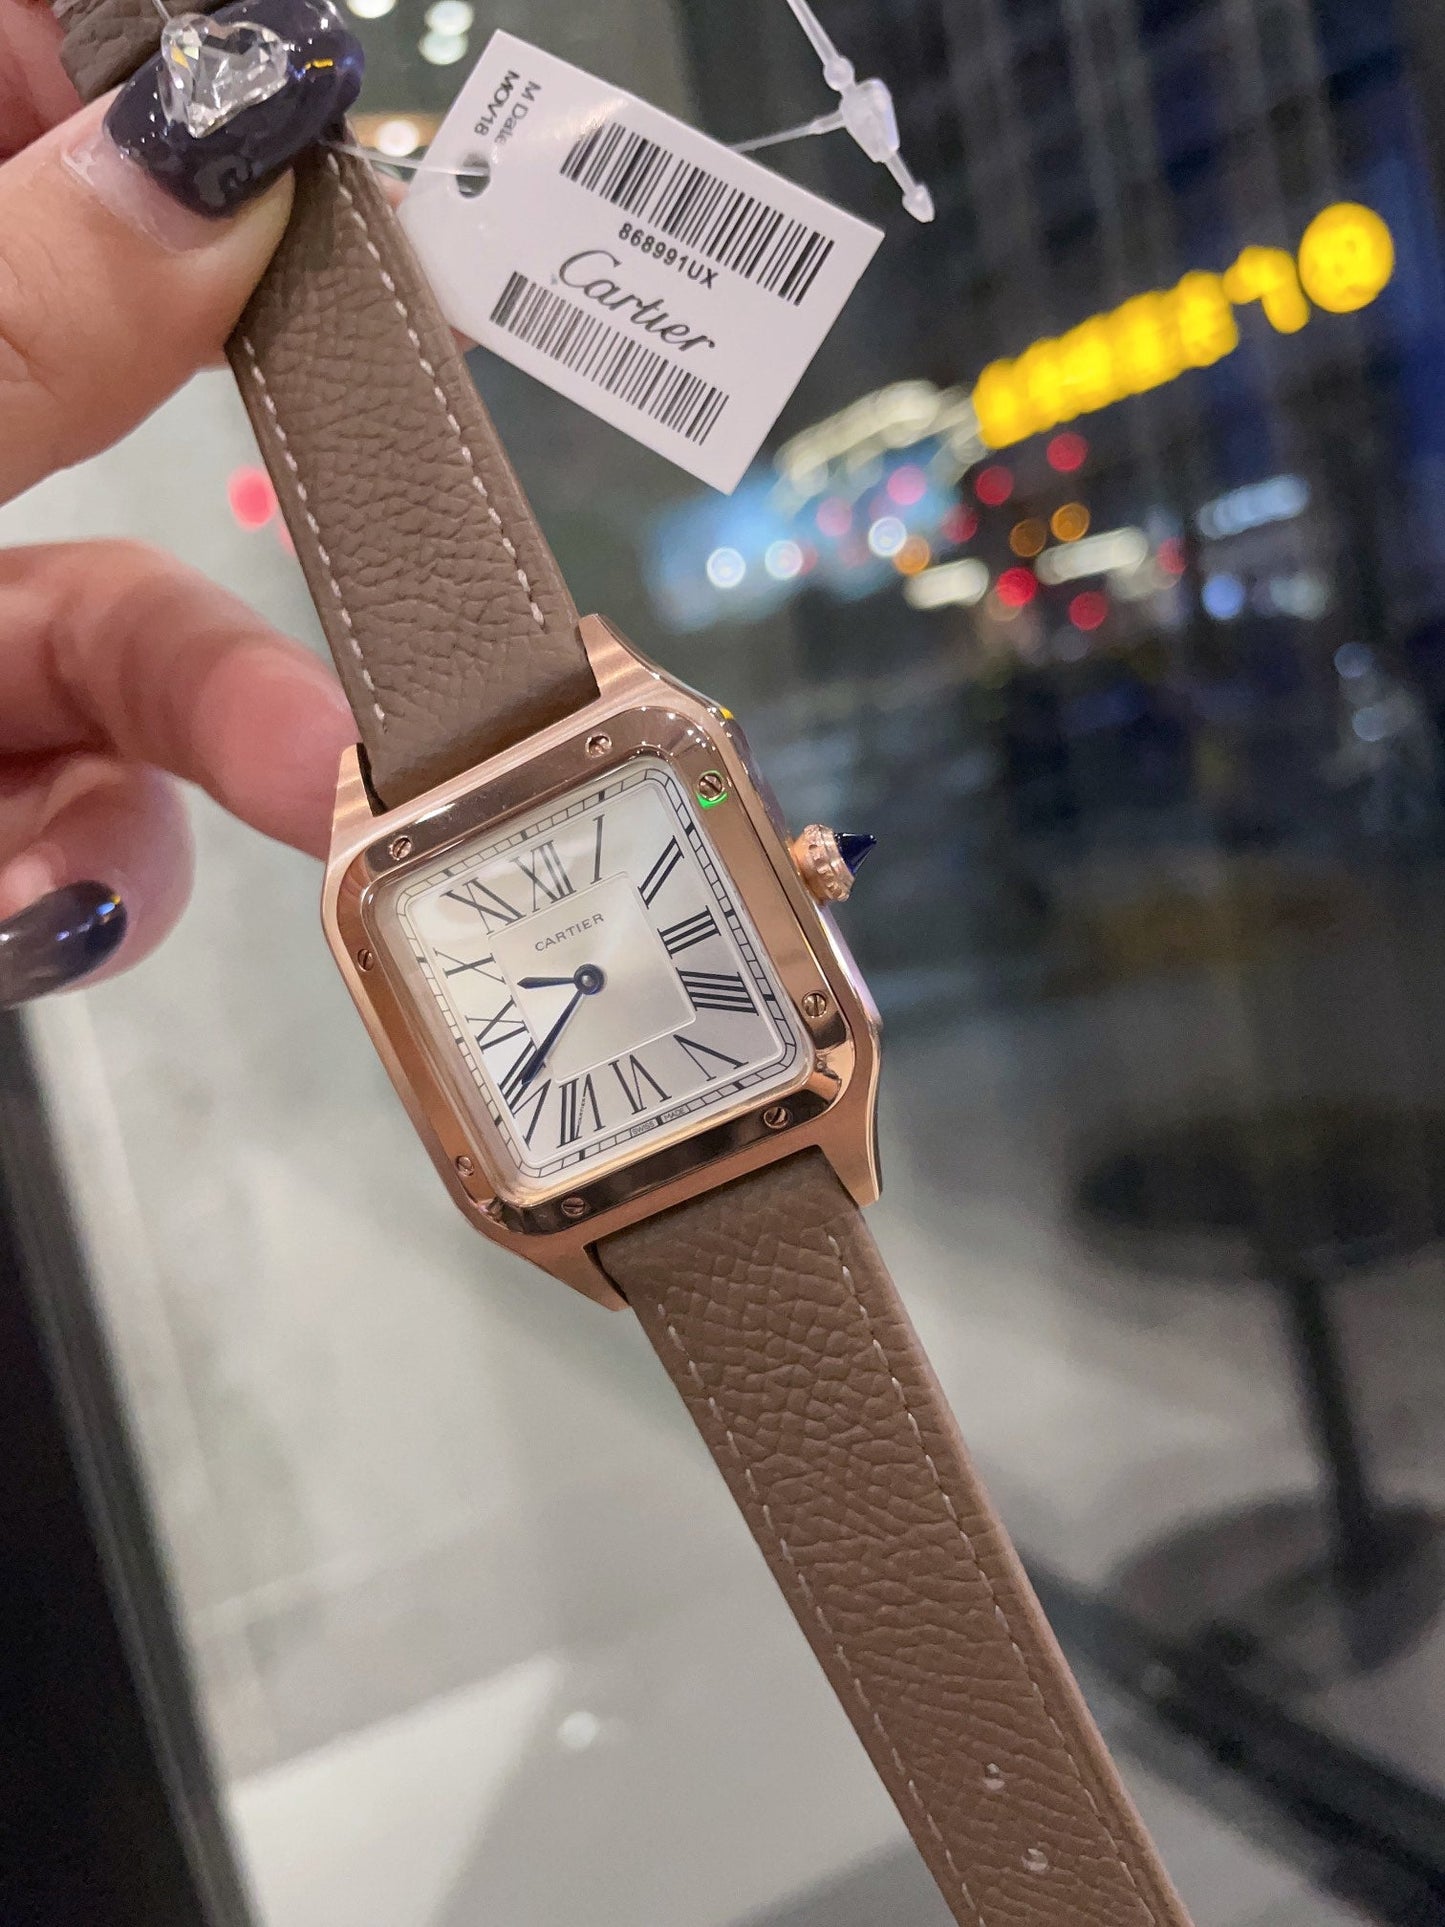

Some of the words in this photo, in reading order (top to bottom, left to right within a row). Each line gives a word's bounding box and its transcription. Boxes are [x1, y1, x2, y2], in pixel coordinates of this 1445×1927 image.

[521, 80, 542, 102] M
[618, 222, 719, 289] 868991UX
[559, 249, 716, 352] Cartier
[509, 840, 577, 912] XII
[637, 835, 684, 910] II
[440, 877, 526, 935] XI
[534, 913, 605, 952] CARTIER
[657, 905, 722, 959] III
[433, 948, 507, 986] X
[465, 995, 530, 1054] IX
[608, 1054, 672, 1115] VI
[673, 1034, 749, 1082] V
[557, 1073, 607, 1149] VII
[631, 1121, 656, 1136] SWISS
[663, 1107, 687, 1121] MADE
